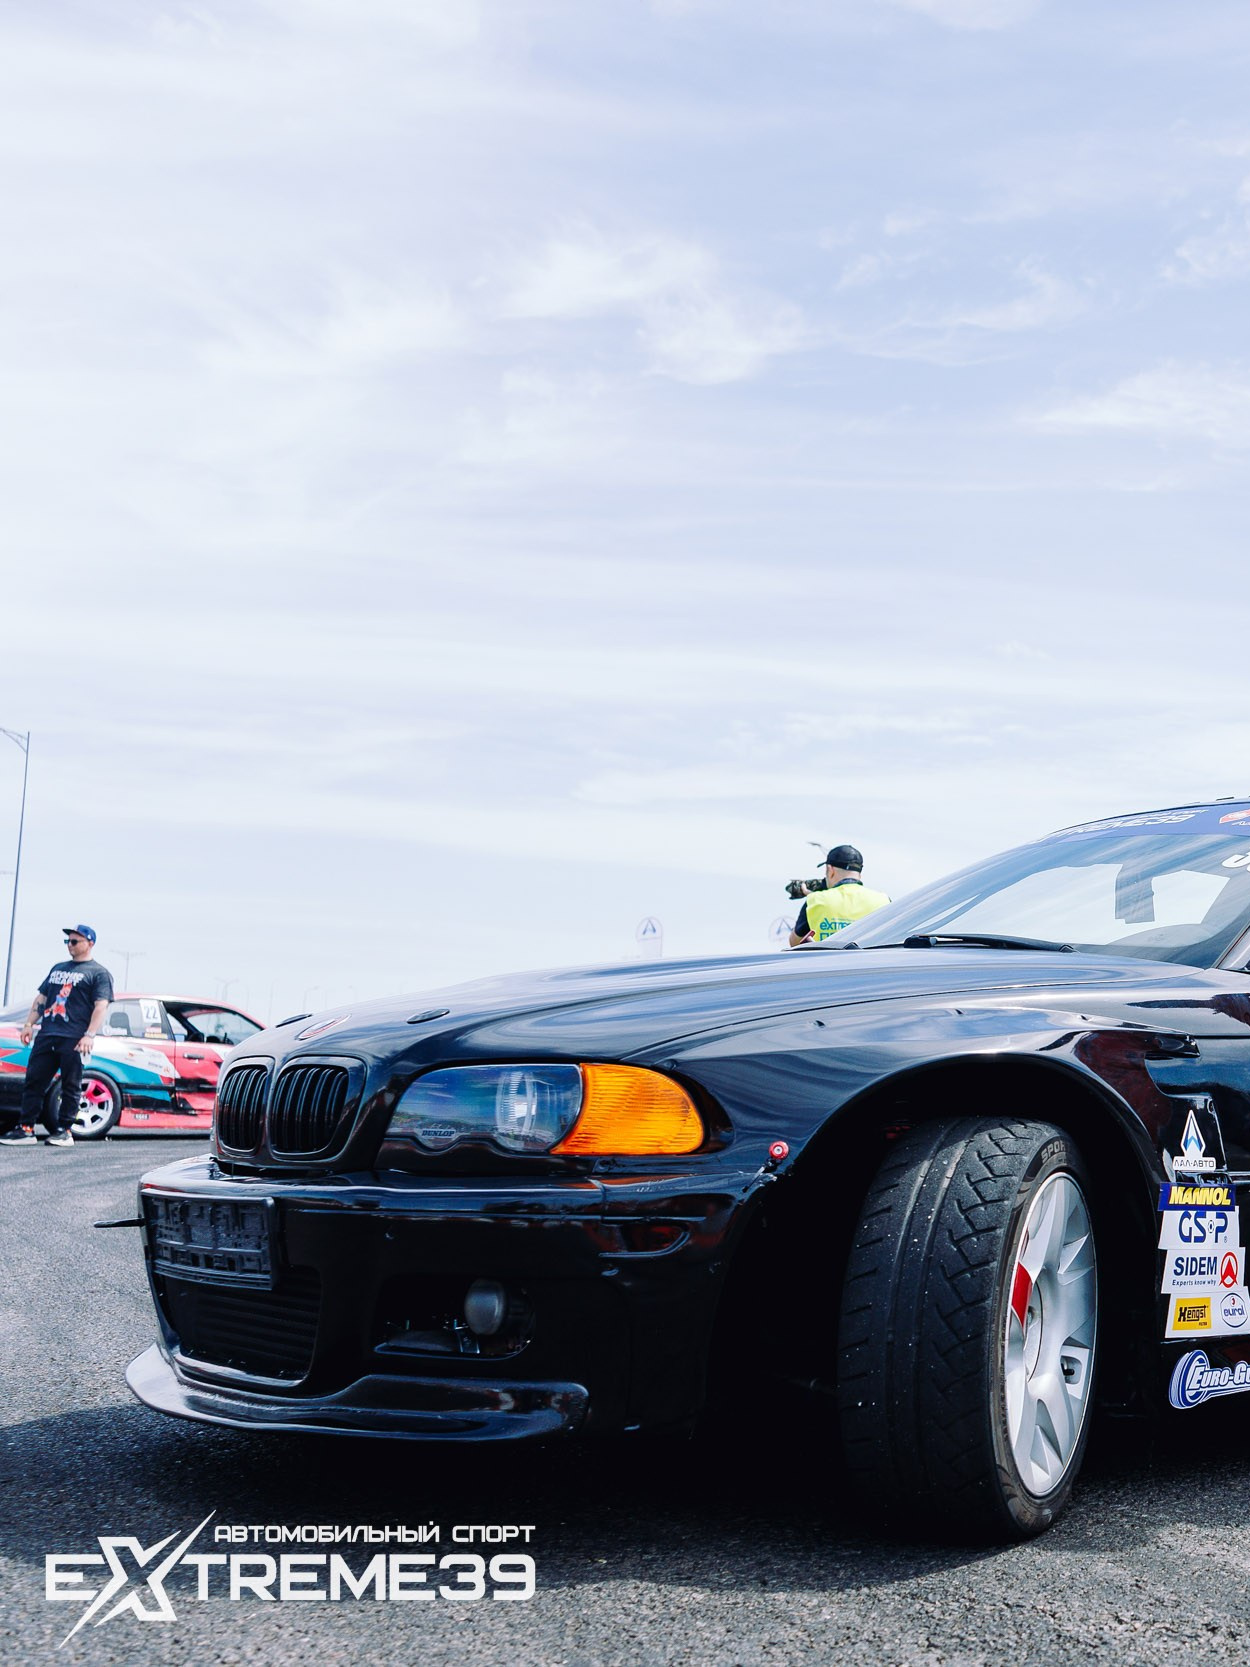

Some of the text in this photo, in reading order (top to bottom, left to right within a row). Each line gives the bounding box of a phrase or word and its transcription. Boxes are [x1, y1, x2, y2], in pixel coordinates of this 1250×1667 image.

[144, 1006, 160, 1020] 22
[1174, 1159, 1215, 1168] ЛАЛ-АВТО
[1169, 1186, 1232, 1206] MANNOL
[1174, 1256, 1217, 1276] SIDEM
[1172, 1279, 1193, 1287] Experts
[1178, 1305, 1208, 1322] Hengst
